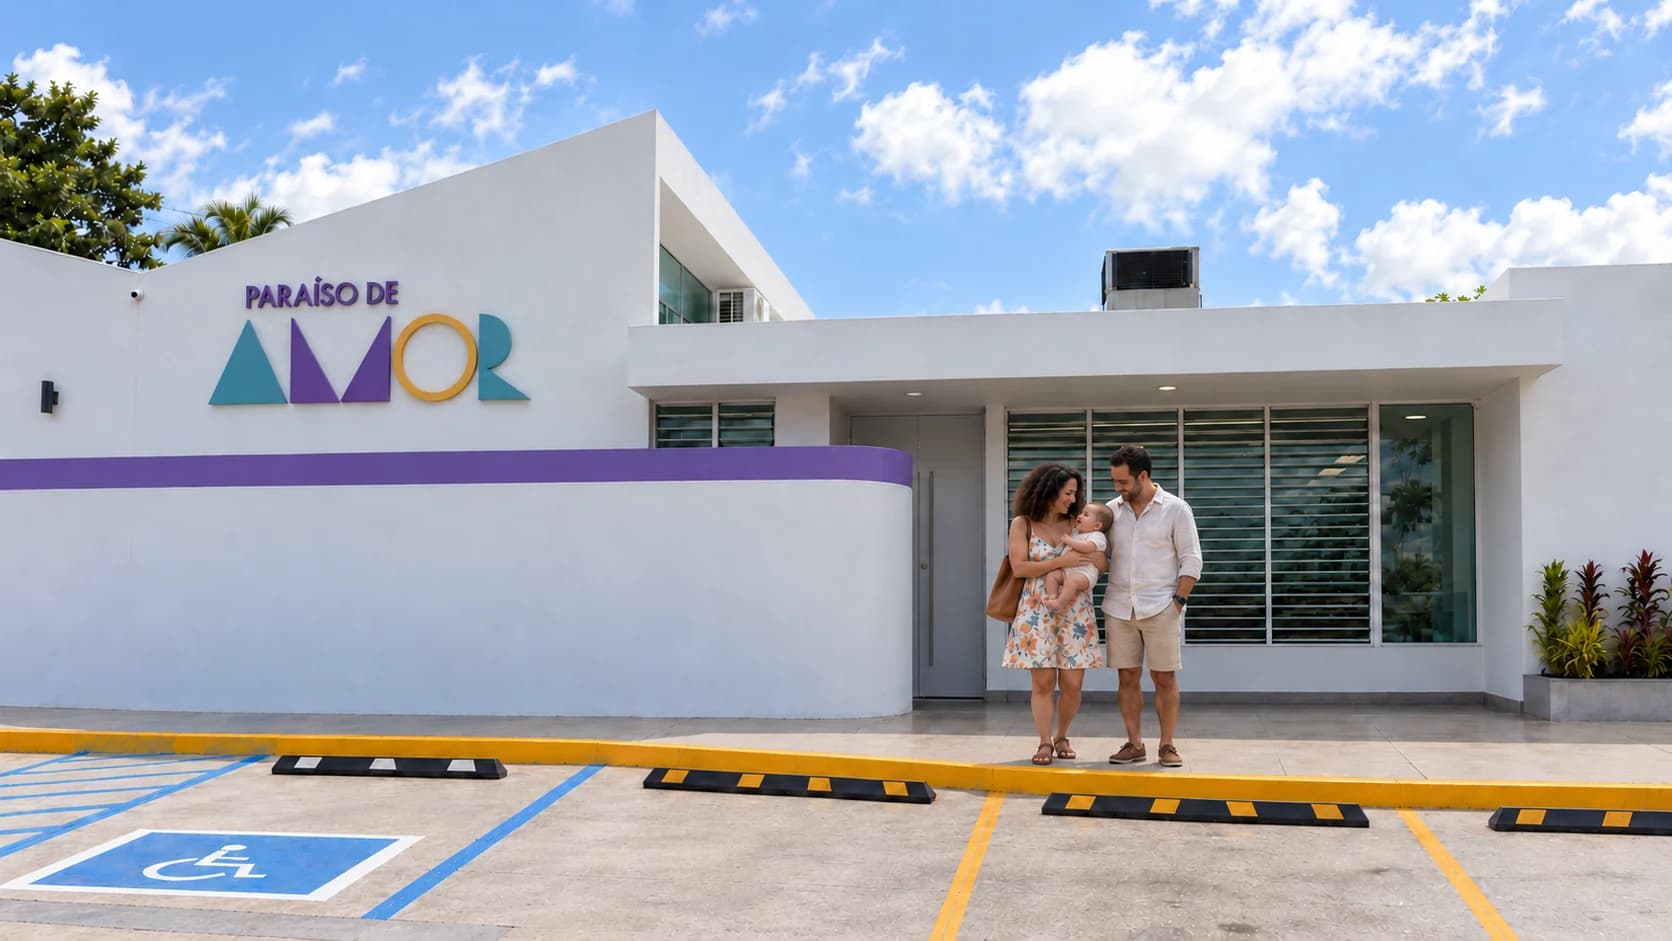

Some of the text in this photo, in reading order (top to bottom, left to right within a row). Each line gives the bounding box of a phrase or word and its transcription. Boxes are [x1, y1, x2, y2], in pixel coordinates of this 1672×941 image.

[245, 276, 399, 309] PARAÍSO DE
[208, 313, 531, 406] AMOR
